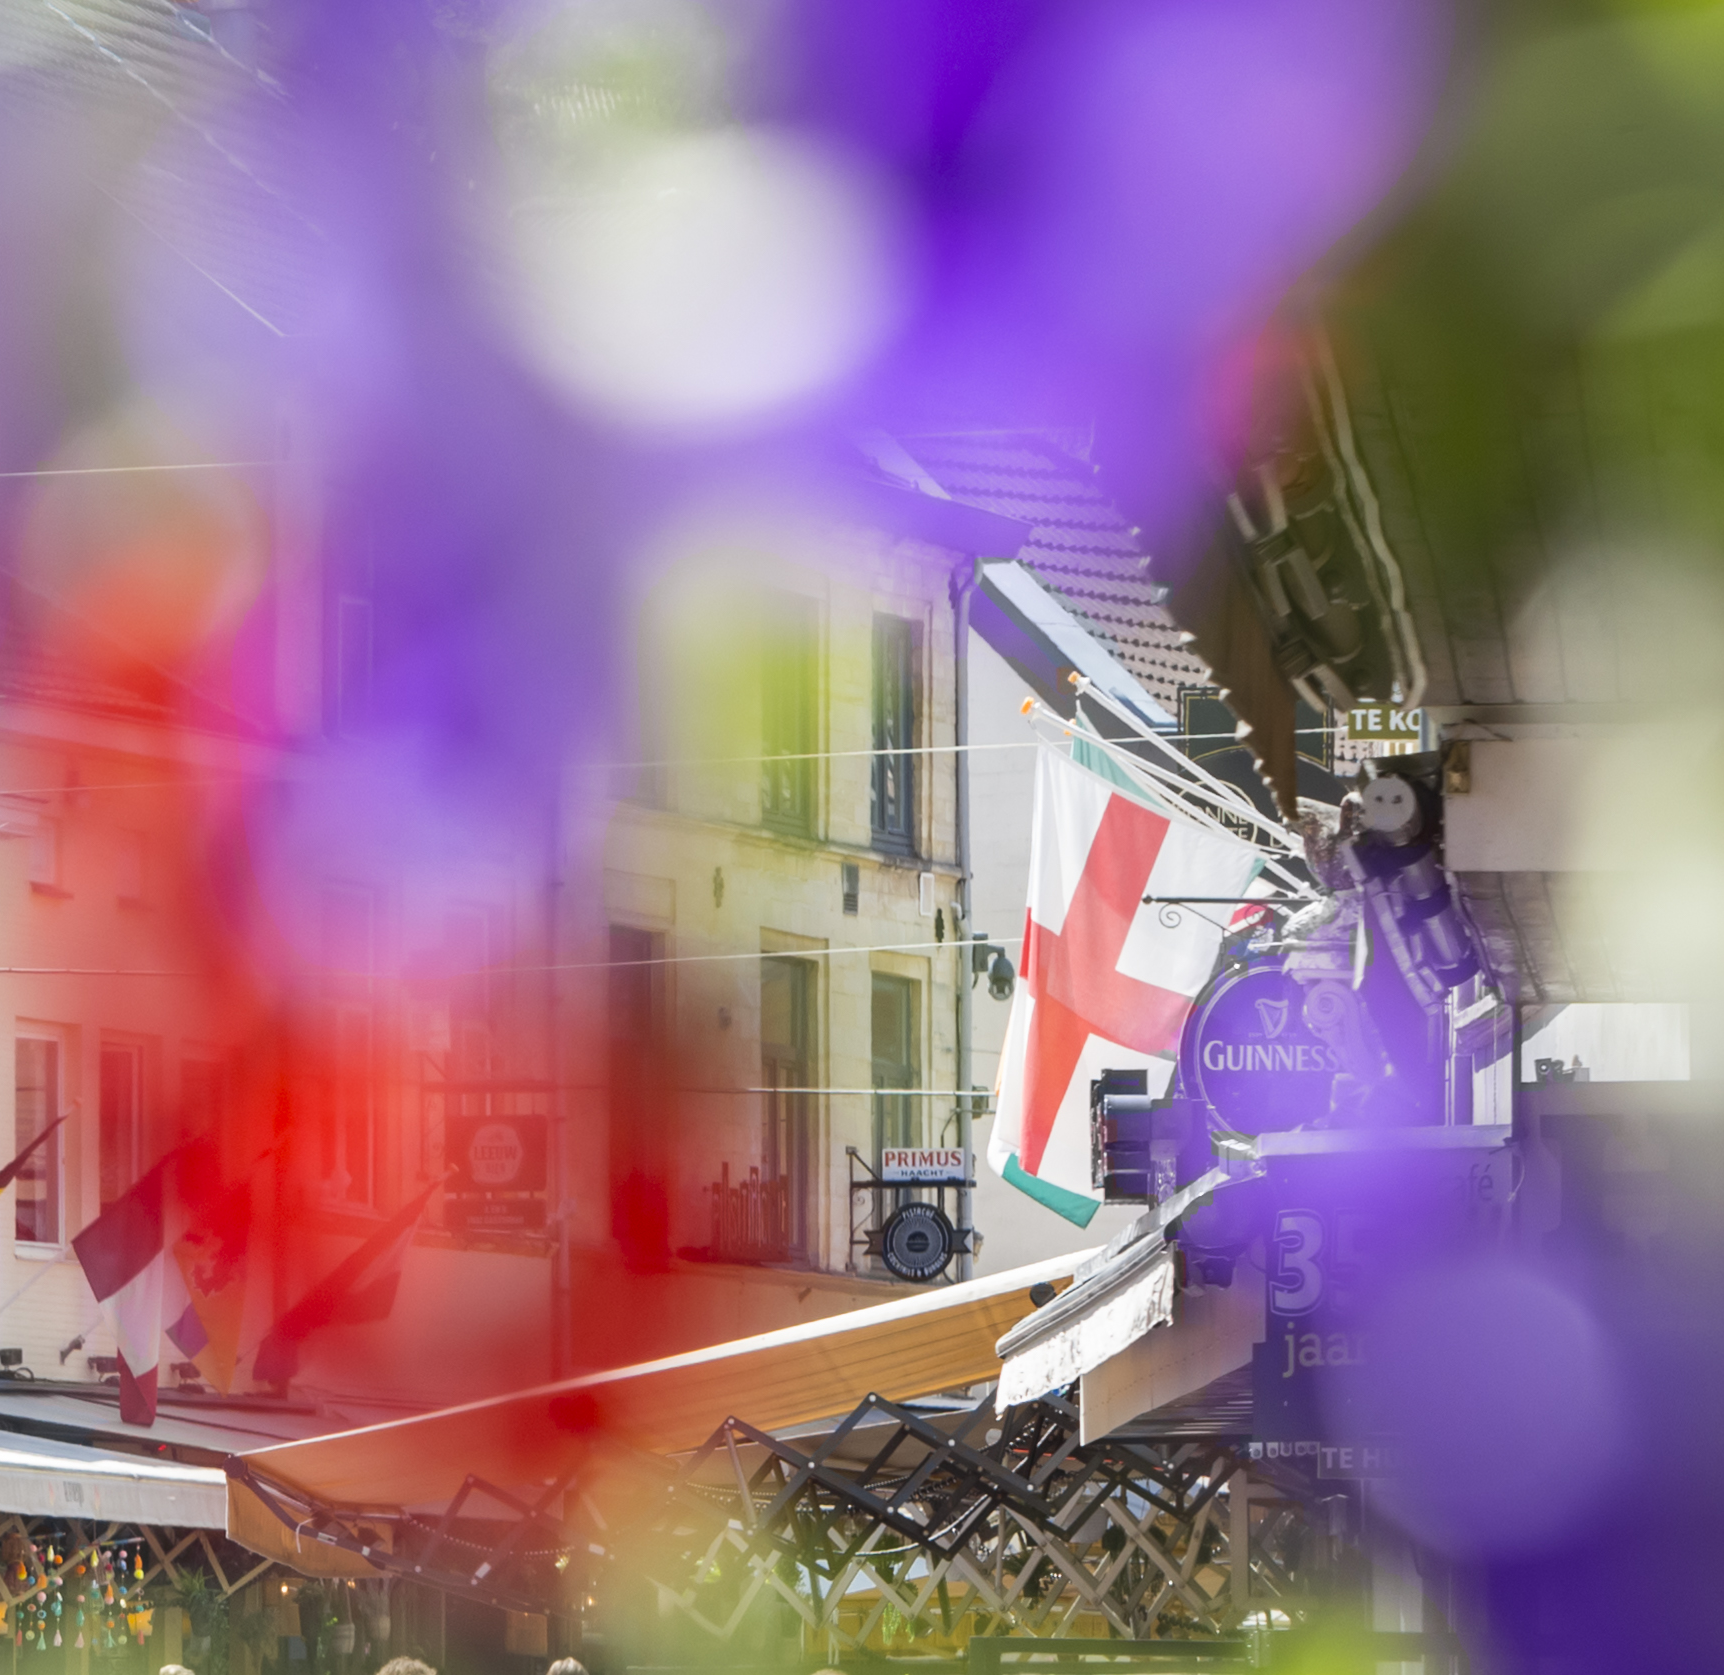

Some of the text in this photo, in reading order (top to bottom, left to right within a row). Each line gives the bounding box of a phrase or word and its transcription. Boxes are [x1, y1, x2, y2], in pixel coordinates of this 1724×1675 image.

[1351, 709, 1382, 731] TE
[1203, 1040, 1340, 1071] GUINNESS
[884, 1151, 962, 1167] PRIMUS
[1321, 1447, 1353, 1469] TE
